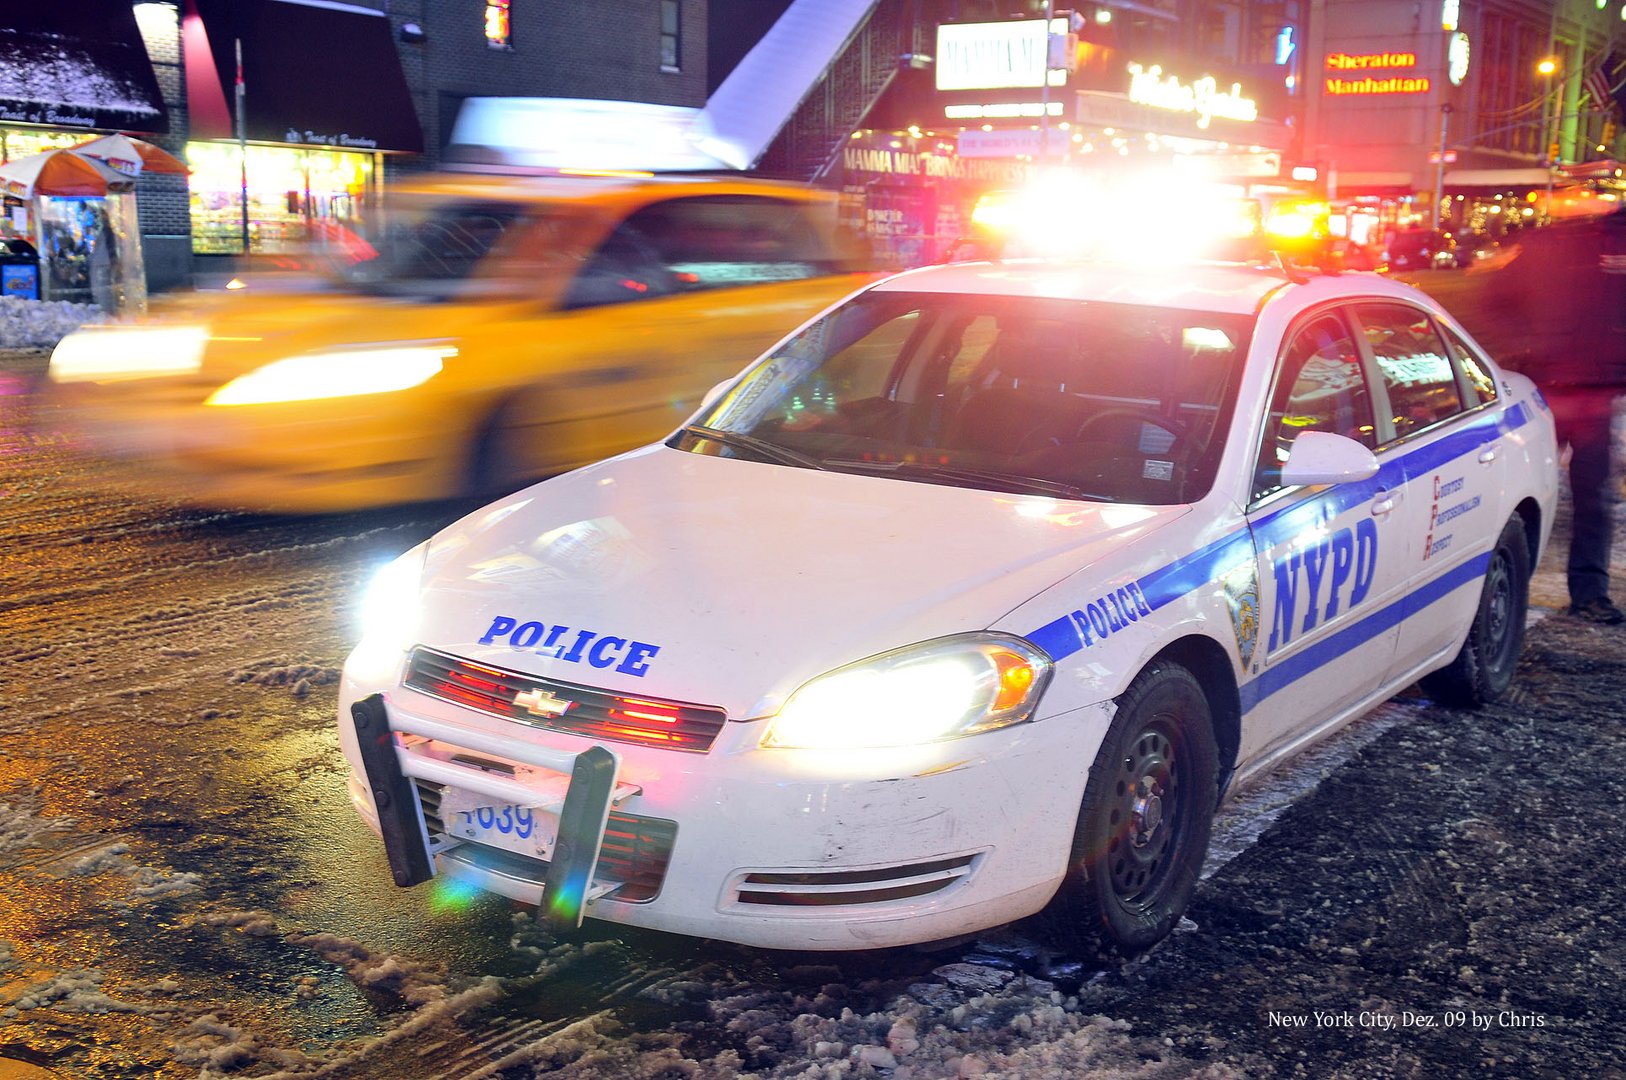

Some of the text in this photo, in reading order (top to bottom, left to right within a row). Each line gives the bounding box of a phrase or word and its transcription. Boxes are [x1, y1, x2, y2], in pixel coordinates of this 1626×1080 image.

[1327, 53, 1416, 69] Sheraton
[1327, 78, 1430, 95] Manhattan
[30, 111, 41, 123] of
[46, 110, 96, 128] Broadway
[844, 148, 892, 173] MAMMA
[894, 151, 921, 175] MIA!
[1268, 517, 1379, 654] NYPD
[1071, 582, 1151, 648] POLICE
[478, 615, 661, 678] POLICE
